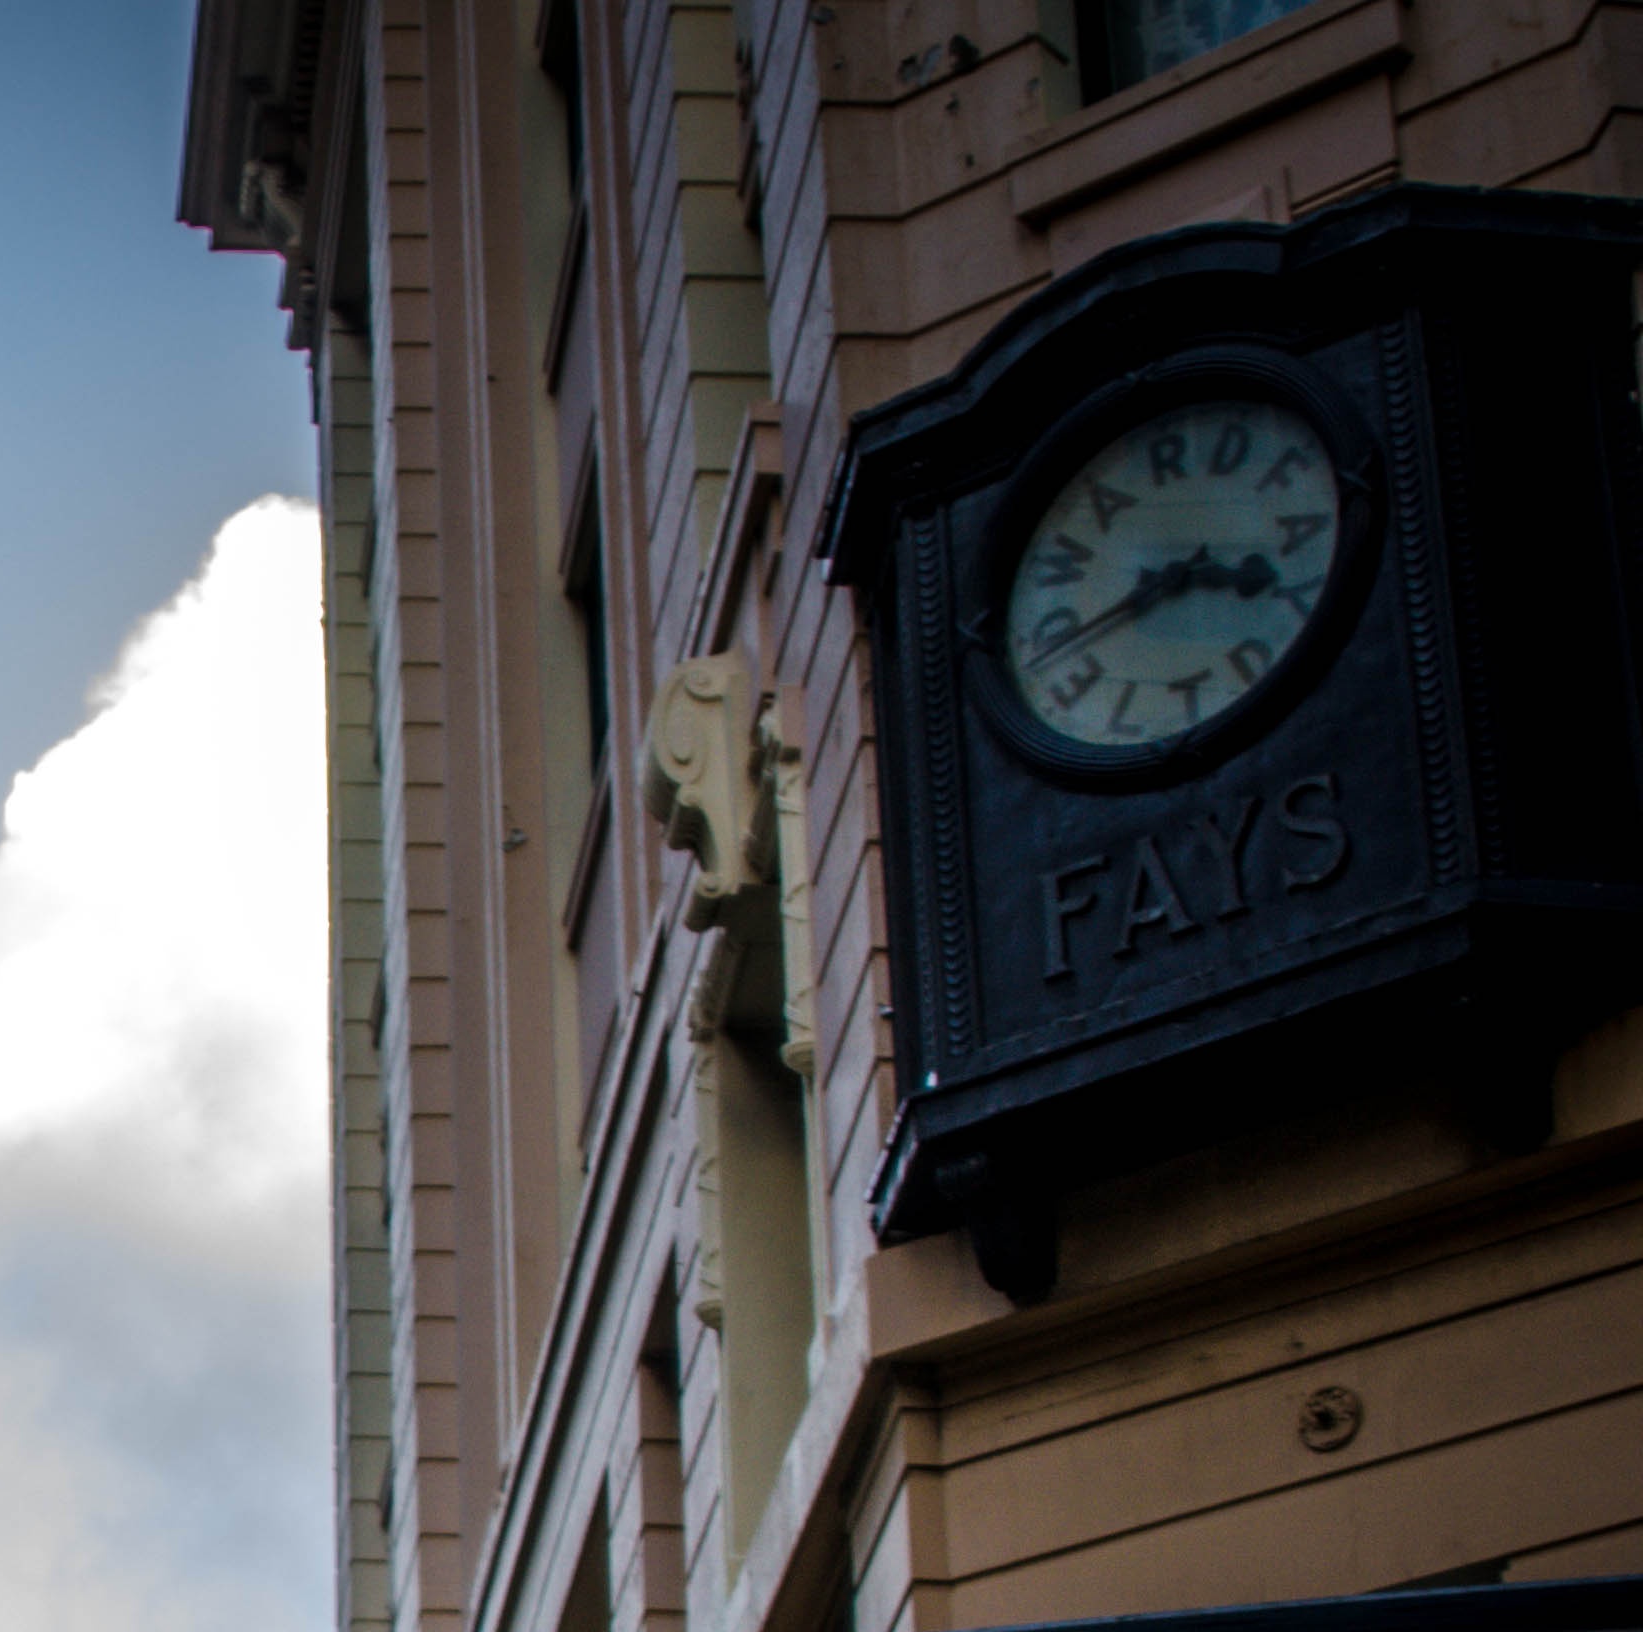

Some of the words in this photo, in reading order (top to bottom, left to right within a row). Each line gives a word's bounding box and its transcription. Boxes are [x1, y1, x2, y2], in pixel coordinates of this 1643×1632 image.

[1031, 426, 1252, 712] EDWARD
[1254, 445, 1331, 618] FAY
[1042, 771, 1354, 984] FAYS
